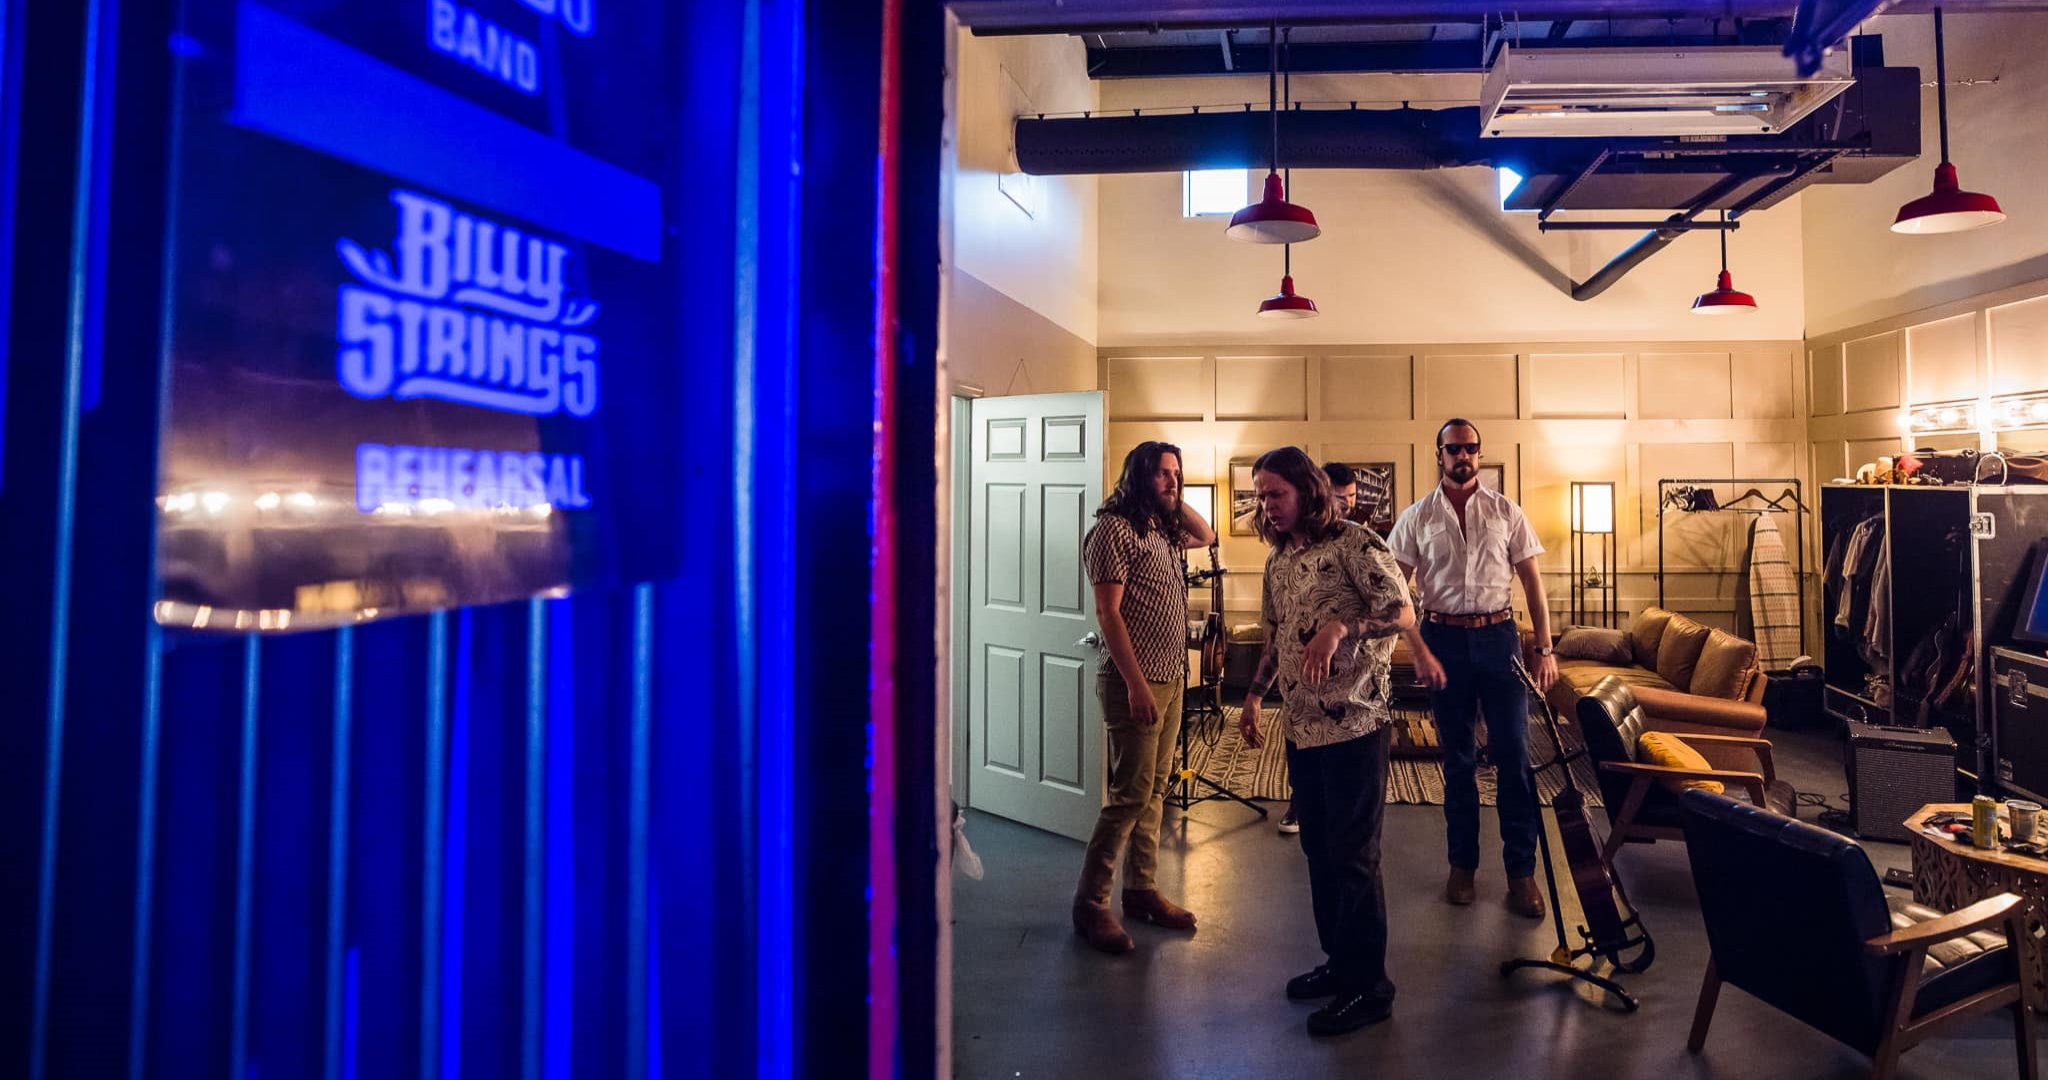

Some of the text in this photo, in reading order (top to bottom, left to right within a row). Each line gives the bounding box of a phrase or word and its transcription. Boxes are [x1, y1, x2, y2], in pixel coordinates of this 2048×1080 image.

[429, 0, 540, 93] BAND
[338, 190, 570, 323] BILLY
[337, 284, 598, 416] STRINGS
[357, 444, 590, 513] REHEARSAL
